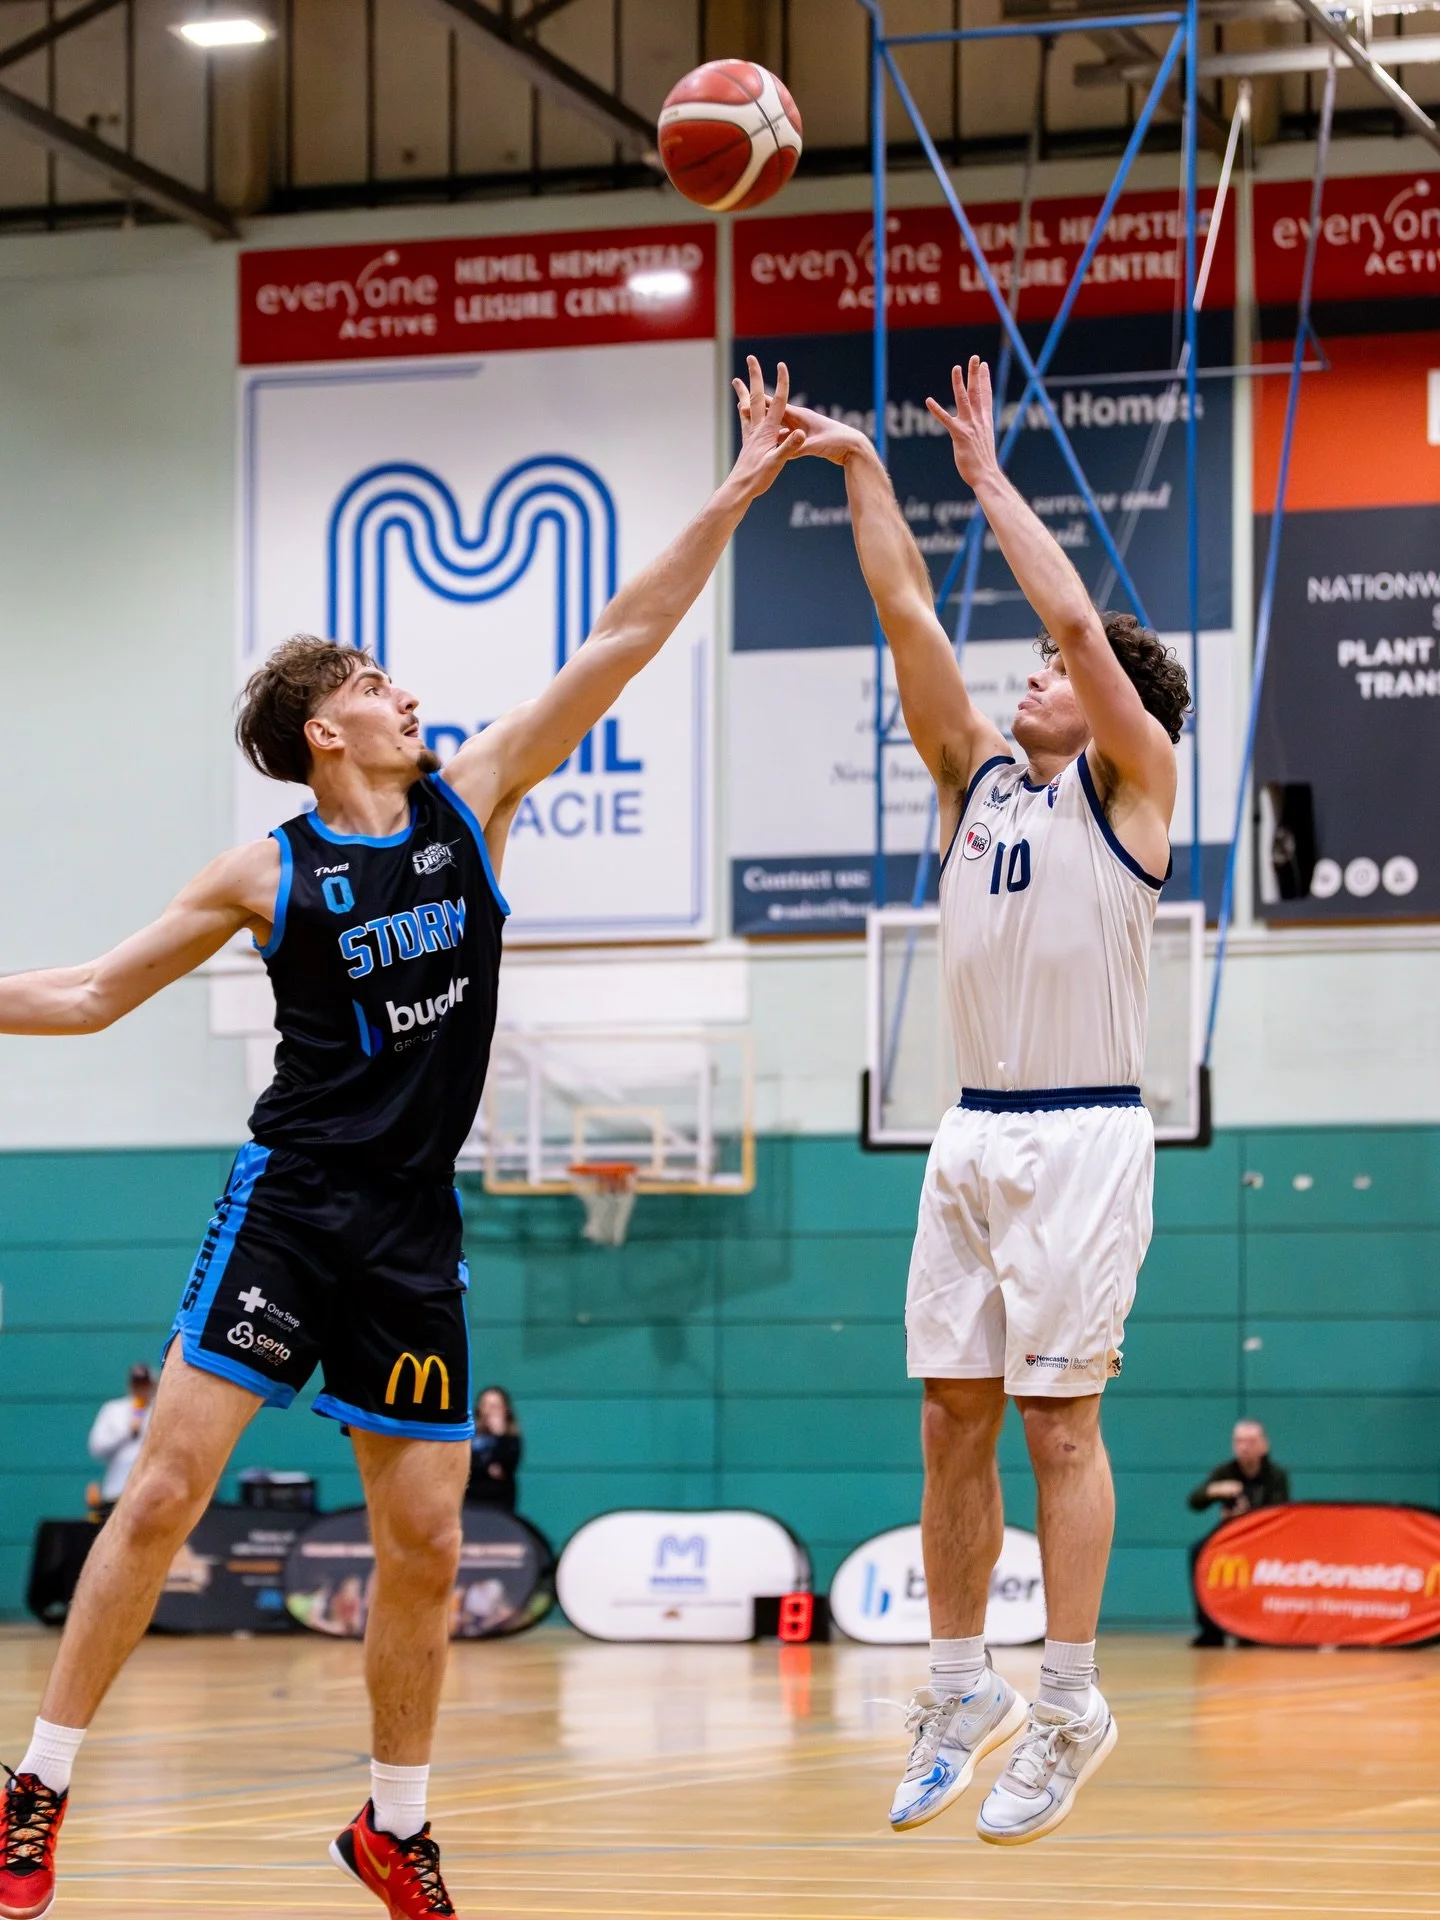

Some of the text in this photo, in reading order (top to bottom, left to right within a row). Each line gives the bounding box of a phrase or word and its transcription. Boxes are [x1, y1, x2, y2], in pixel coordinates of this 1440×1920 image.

[256, 250, 439, 317] everyone
[455, 253, 543, 285] HEMEL
[1082, 250, 1179, 285] ENTRE
[454, 290, 559, 324] LEISURE
[338, 312, 438, 340] ACTIVE
[1337, 635, 1435, 667] PLANT
[1356, 667, 1440, 700] TRAN
[989, 838, 1031, 895] 10
[267, 1303, 301, 1329] One Stop
[256, 1334, 291, 1361] certa
[1036, 1354, 1070, 1364] Newcastle
